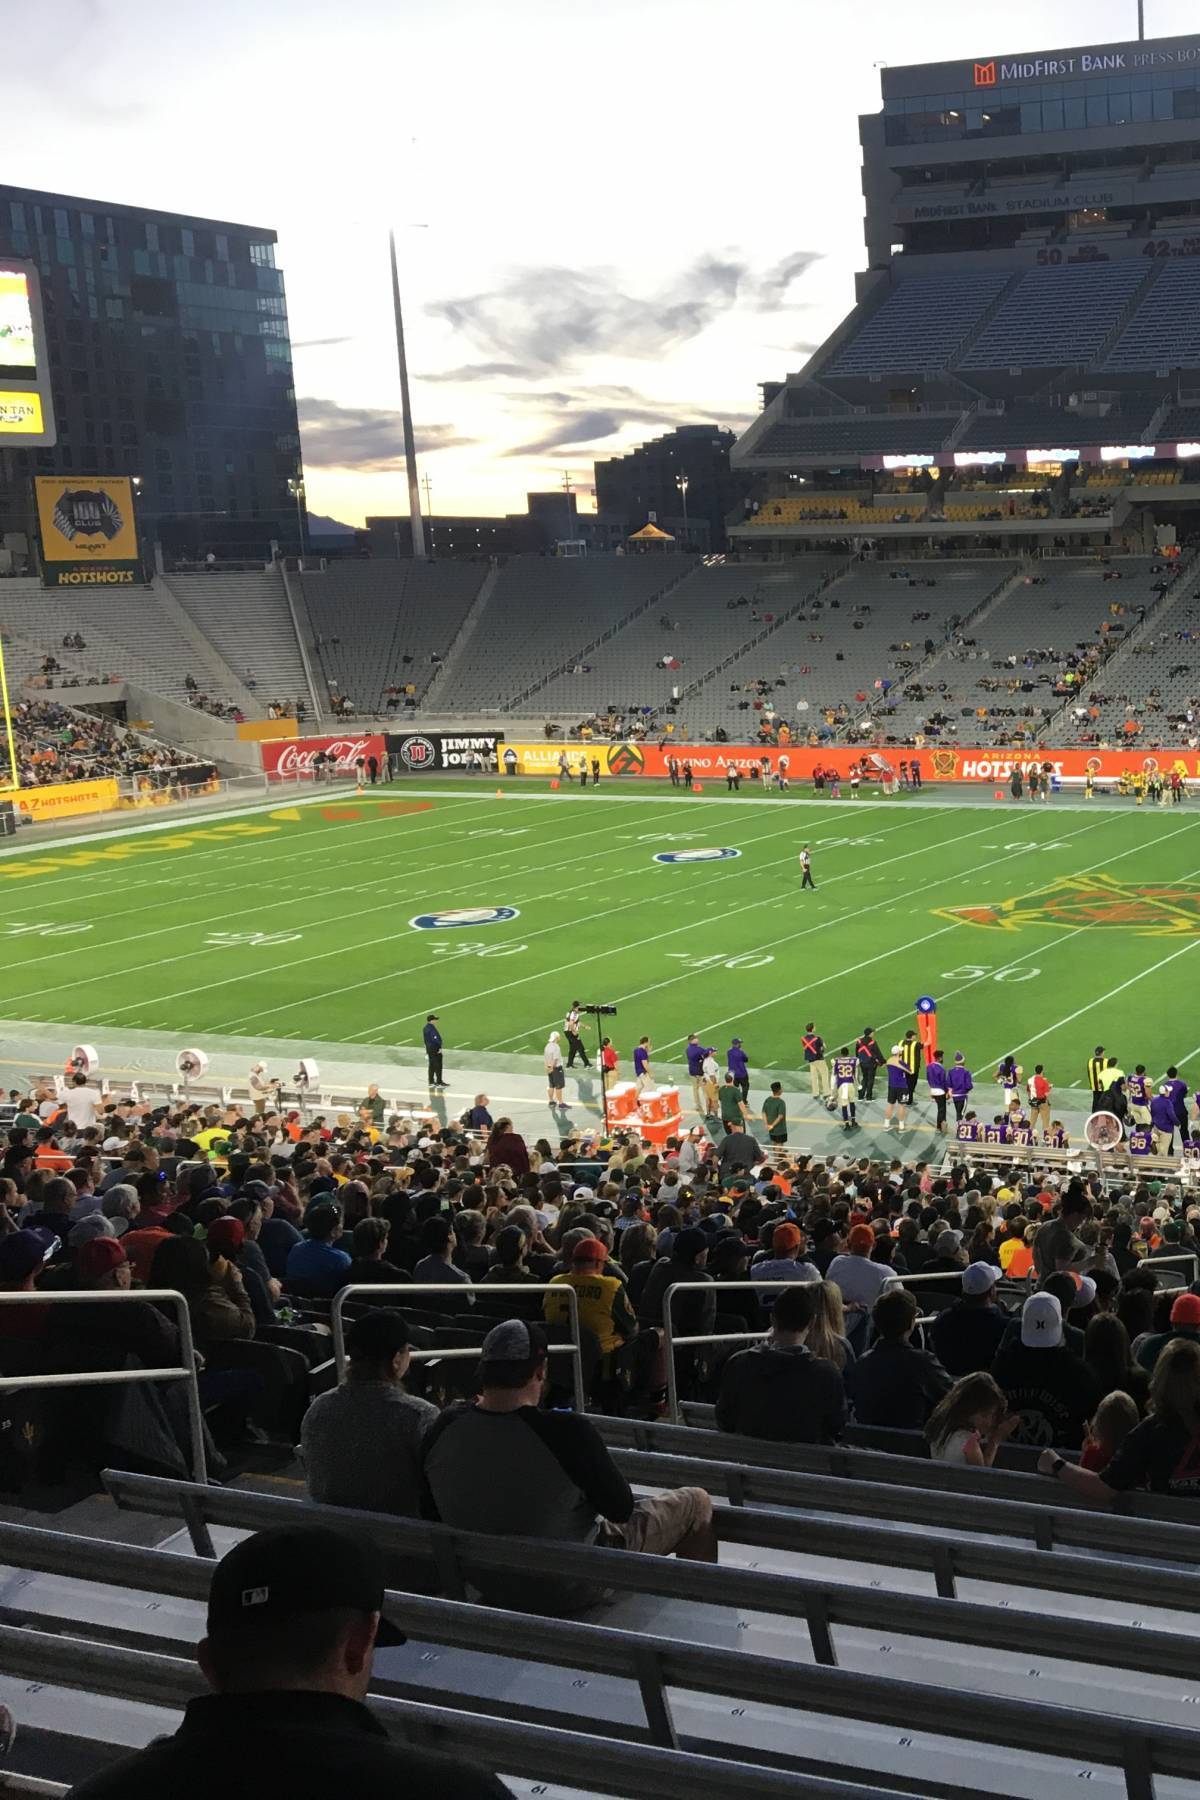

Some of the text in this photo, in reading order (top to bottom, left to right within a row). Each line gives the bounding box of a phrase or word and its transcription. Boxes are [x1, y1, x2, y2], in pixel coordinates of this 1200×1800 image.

[1081, 55, 1125, 72] BANK
[1133, 49, 1174, 67] PRESS
[968, 202, 998, 214] BANK
[1006, 197, 1070, 211] STADIUM
[1073, 192, 1114, 206] CLUB
[1142, 240, 1171, 257] 42
[1037, 248, 1063, 266] 50
[12, 406, 34, 415] TAN
[58, 571, 134, 585] HOTSHOTS
[440, 737, 495, 753] JIMMY
[41, 792, 98, 808] HOTSHOTS
[431, 942, 529, 958] 30
[680, 953, 776, 970] 40
[940, 964, 1043, 982] 50
[837, 1064, 853, 1078] 32
[959, 1126, 972, 1139] 31
[987, 1131, 1000, 1144] 21
[1014, 1131, 1028, 1145] 30
[898, 1737, 912, 1747] 18
